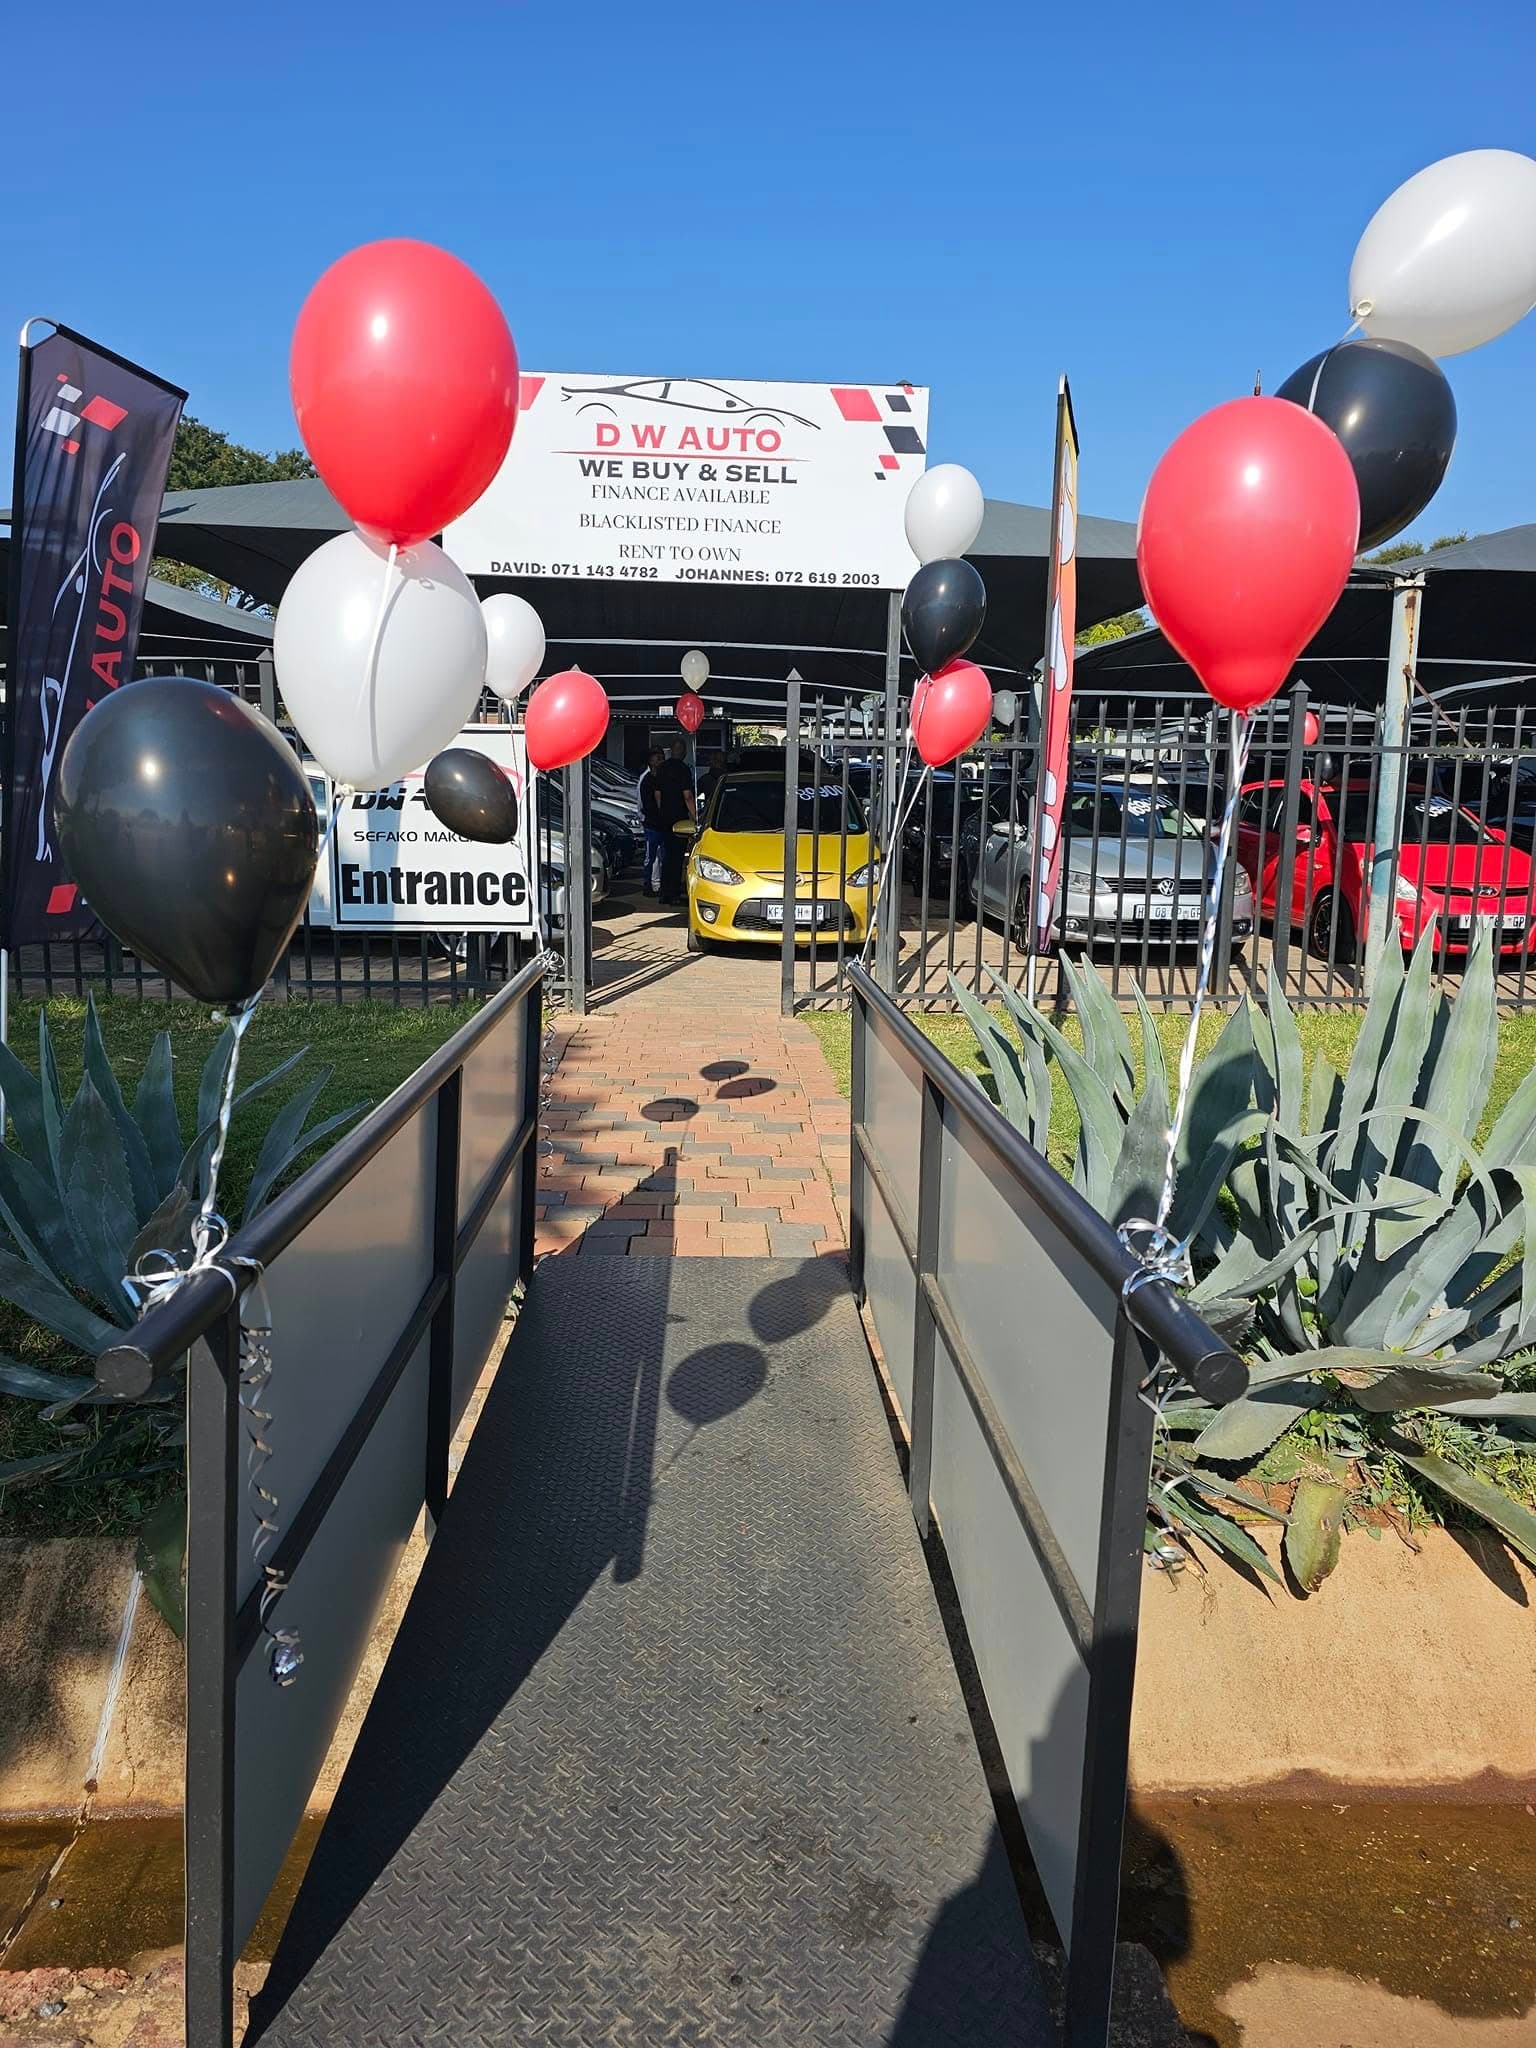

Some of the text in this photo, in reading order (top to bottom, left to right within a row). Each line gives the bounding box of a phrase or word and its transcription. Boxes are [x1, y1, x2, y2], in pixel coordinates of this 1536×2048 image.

[596, 423, 781, 453] D W AUTO
[579, 459, 797, 485] WE BUY & SELL
[592, 485, 769, 505] FINANCE AVAILABLE
[580, 513, 781, 535] BLACKLISTED FINANCE
[619, 544, 742, 562] RENT TO OWN
[490, 562, 880, 586] DAVID: 071 143 4782 JOHANNES: 072 619 2003
[91, 522, 141, 688] AUTO
[353, 831, 418, 843] SEFAKO
[342, 864, 526, 906] Entrance
